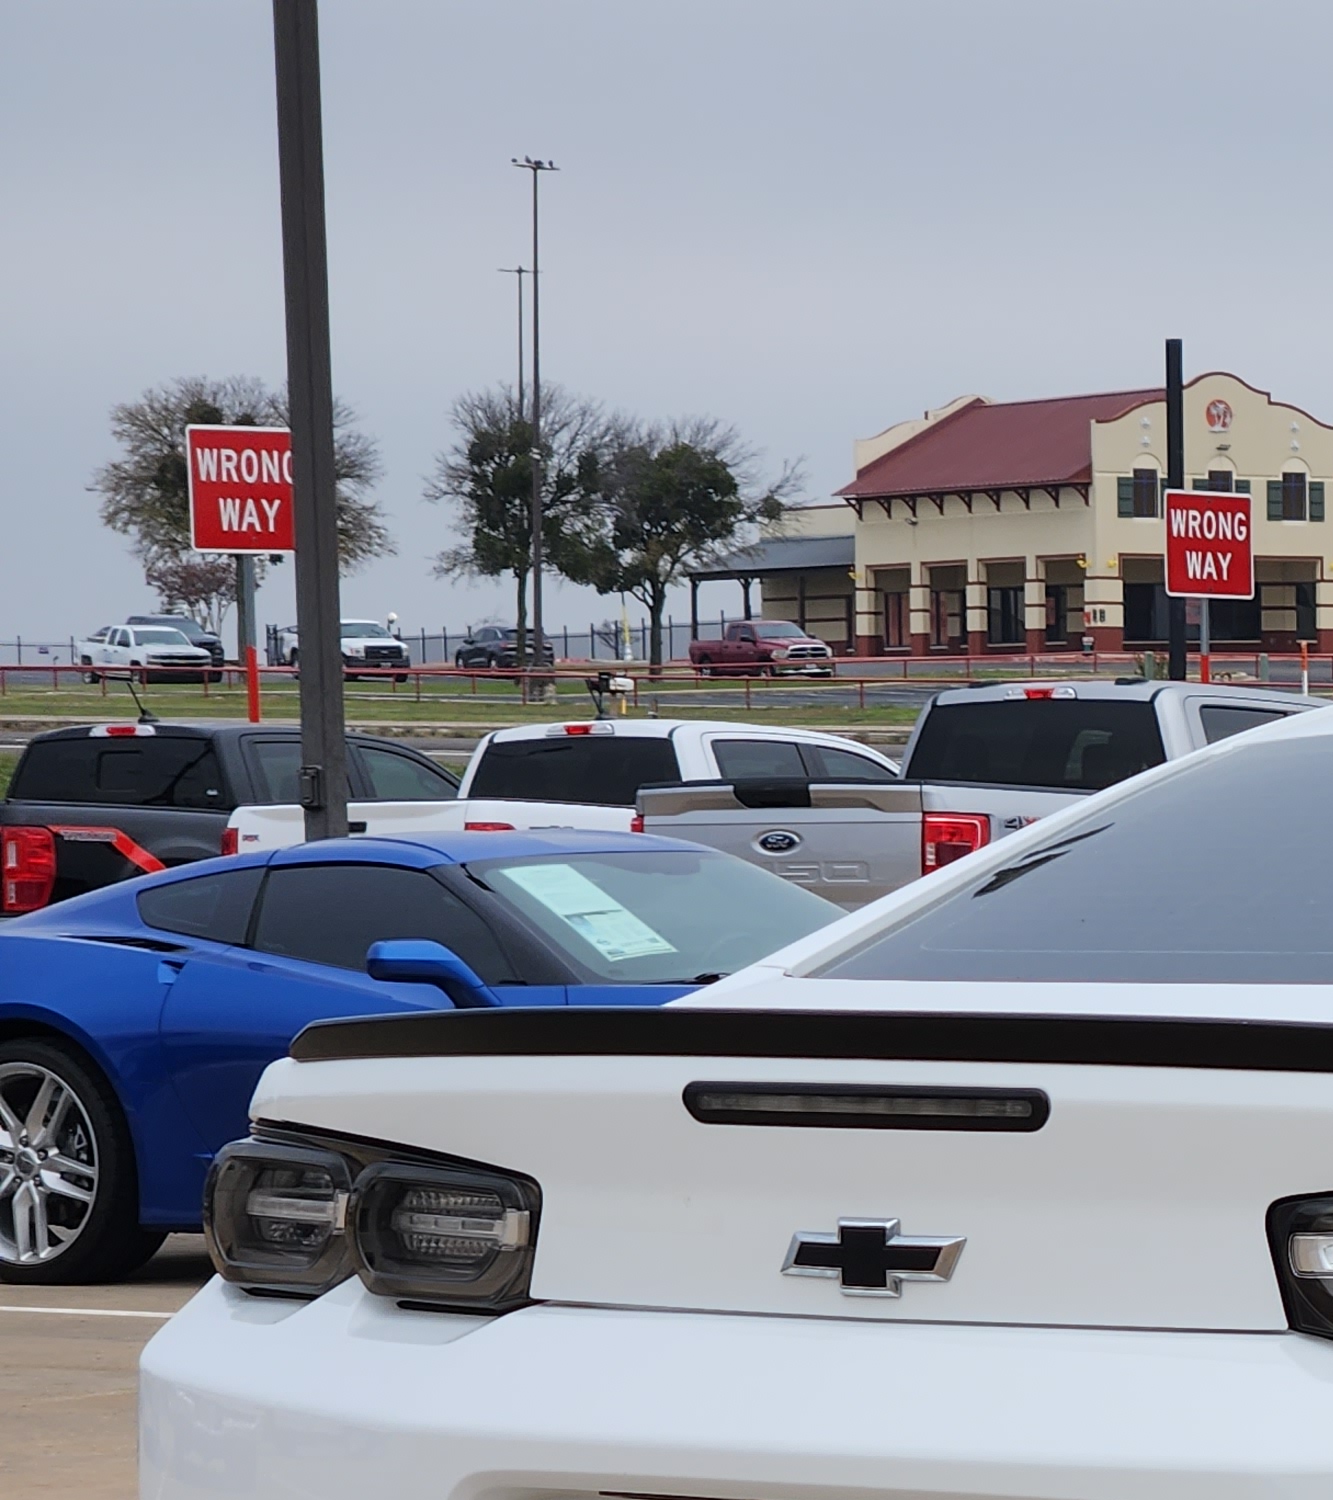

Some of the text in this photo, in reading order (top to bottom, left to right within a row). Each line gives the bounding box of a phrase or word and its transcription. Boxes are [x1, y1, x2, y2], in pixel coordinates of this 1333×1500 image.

[219, 497, 281, 533] WAY
[1170, 508, 1247, 541] WRONG
[1185, 550, 1232, 581] WAY
